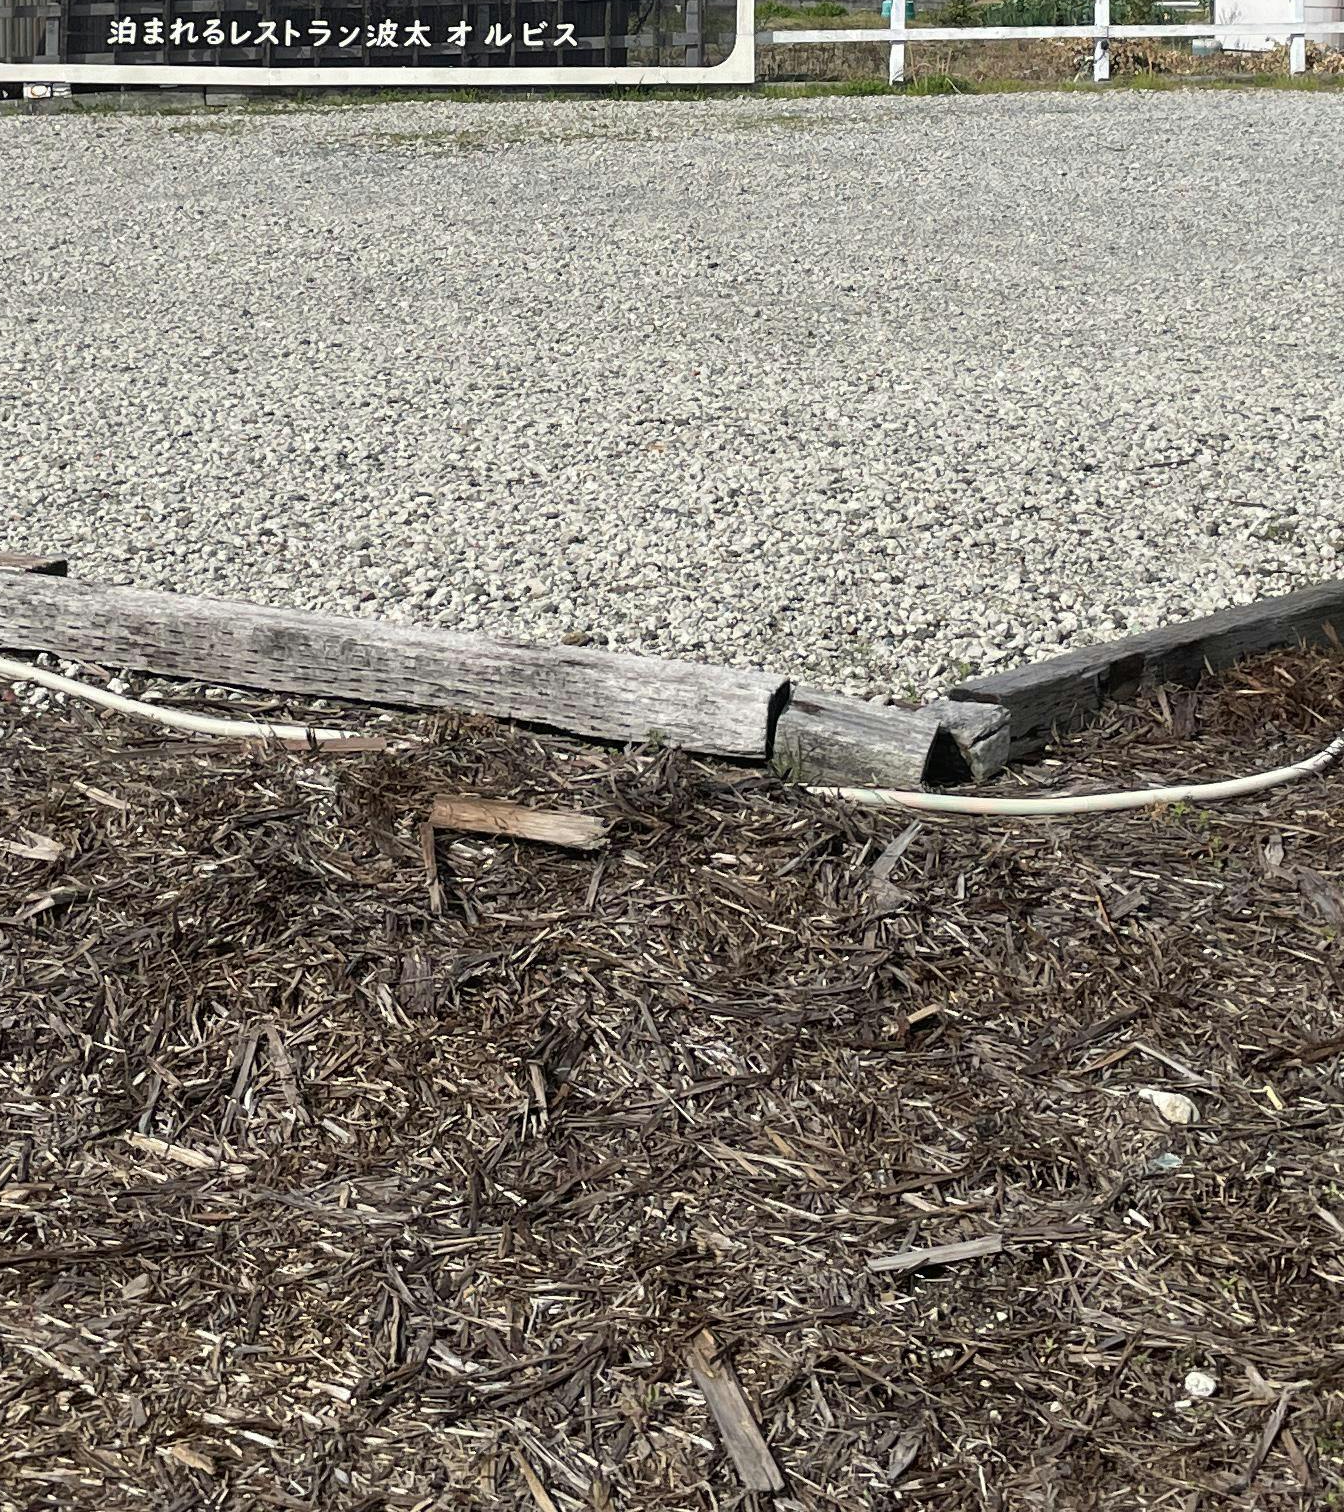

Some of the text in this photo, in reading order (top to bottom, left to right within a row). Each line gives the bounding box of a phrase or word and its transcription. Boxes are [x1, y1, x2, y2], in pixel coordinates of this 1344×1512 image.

[107, 17, 578, 47] 泊まれるレストラン波太 オルビス
